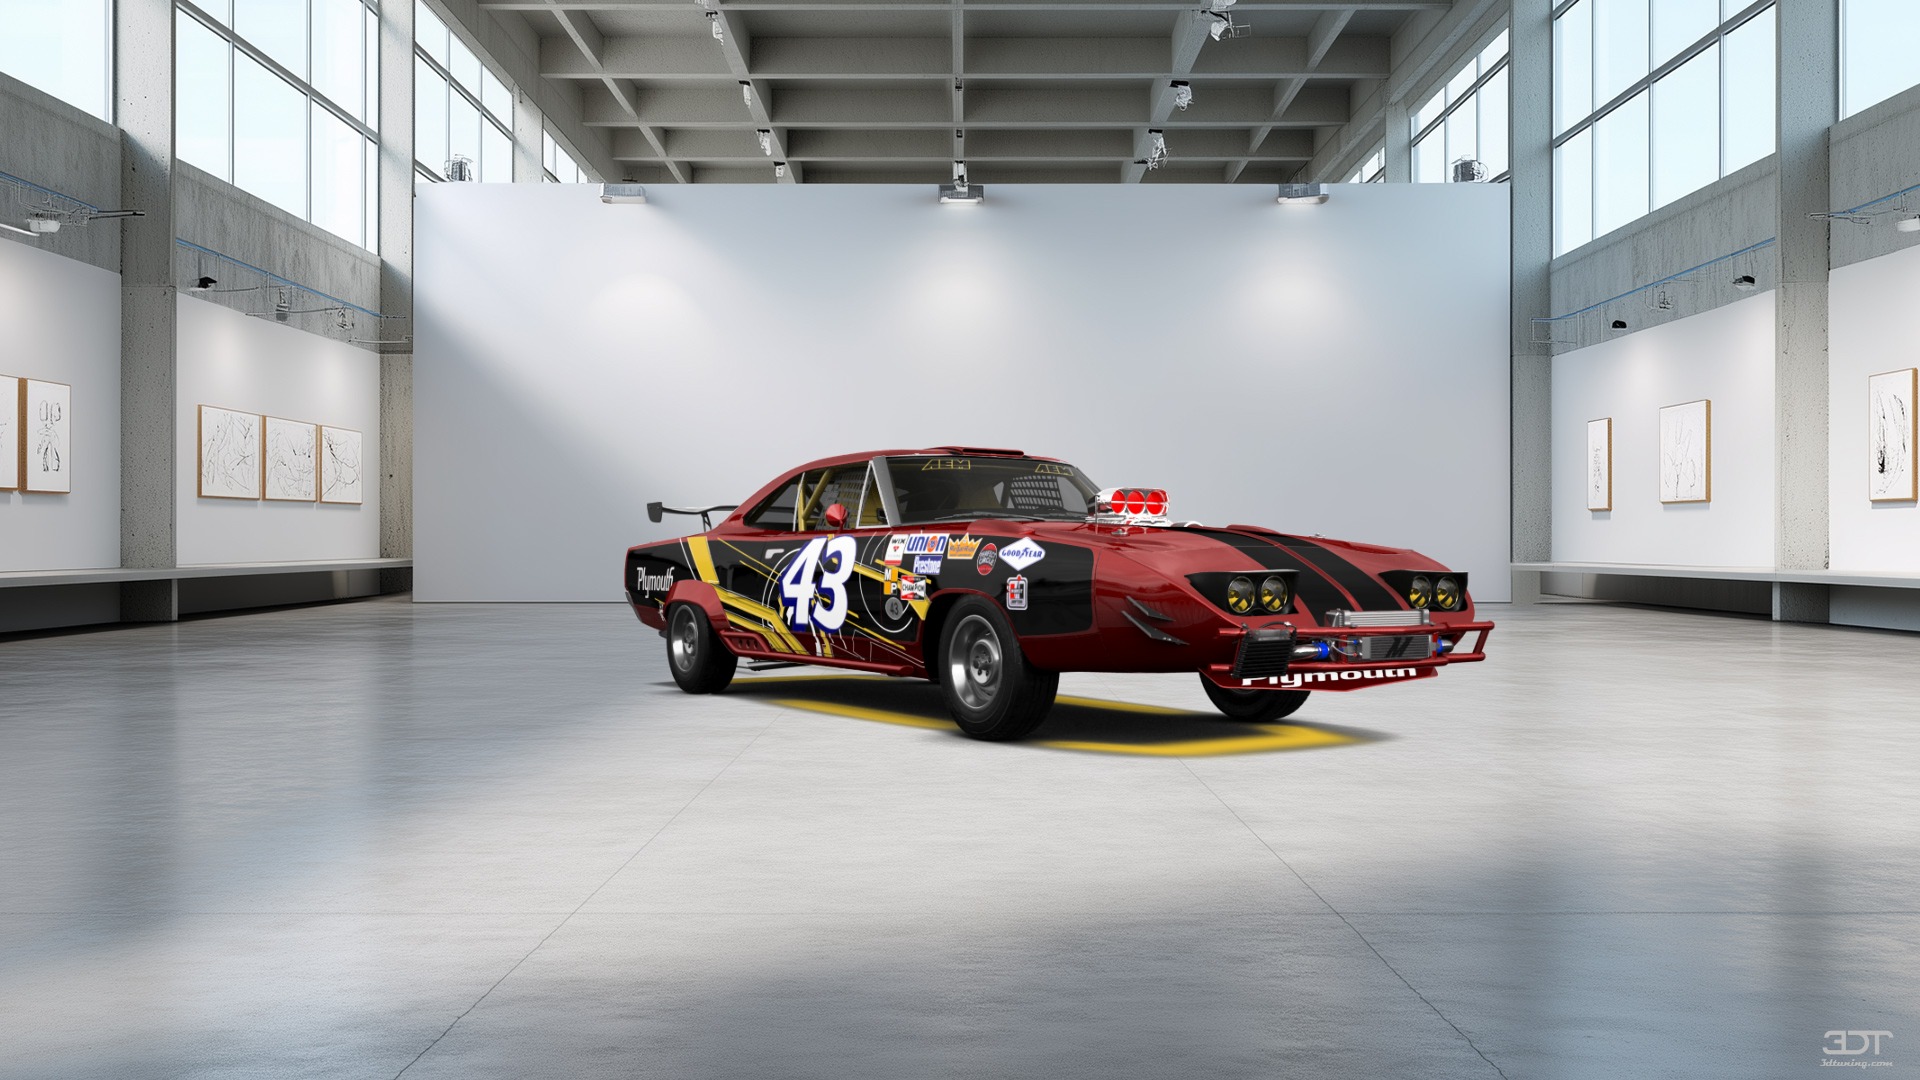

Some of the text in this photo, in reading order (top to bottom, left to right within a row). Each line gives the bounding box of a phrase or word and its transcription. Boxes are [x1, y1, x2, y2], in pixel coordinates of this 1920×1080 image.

[921, 459, 971, 471] AEM
[1034, 463, 1074, 476] AEM
[913, 556, 942, 574] Prestone
[637, 566, 675, 599] Plymouth
[780, 535, 857, 632] 43
[890, 601, 899, 616] 43
